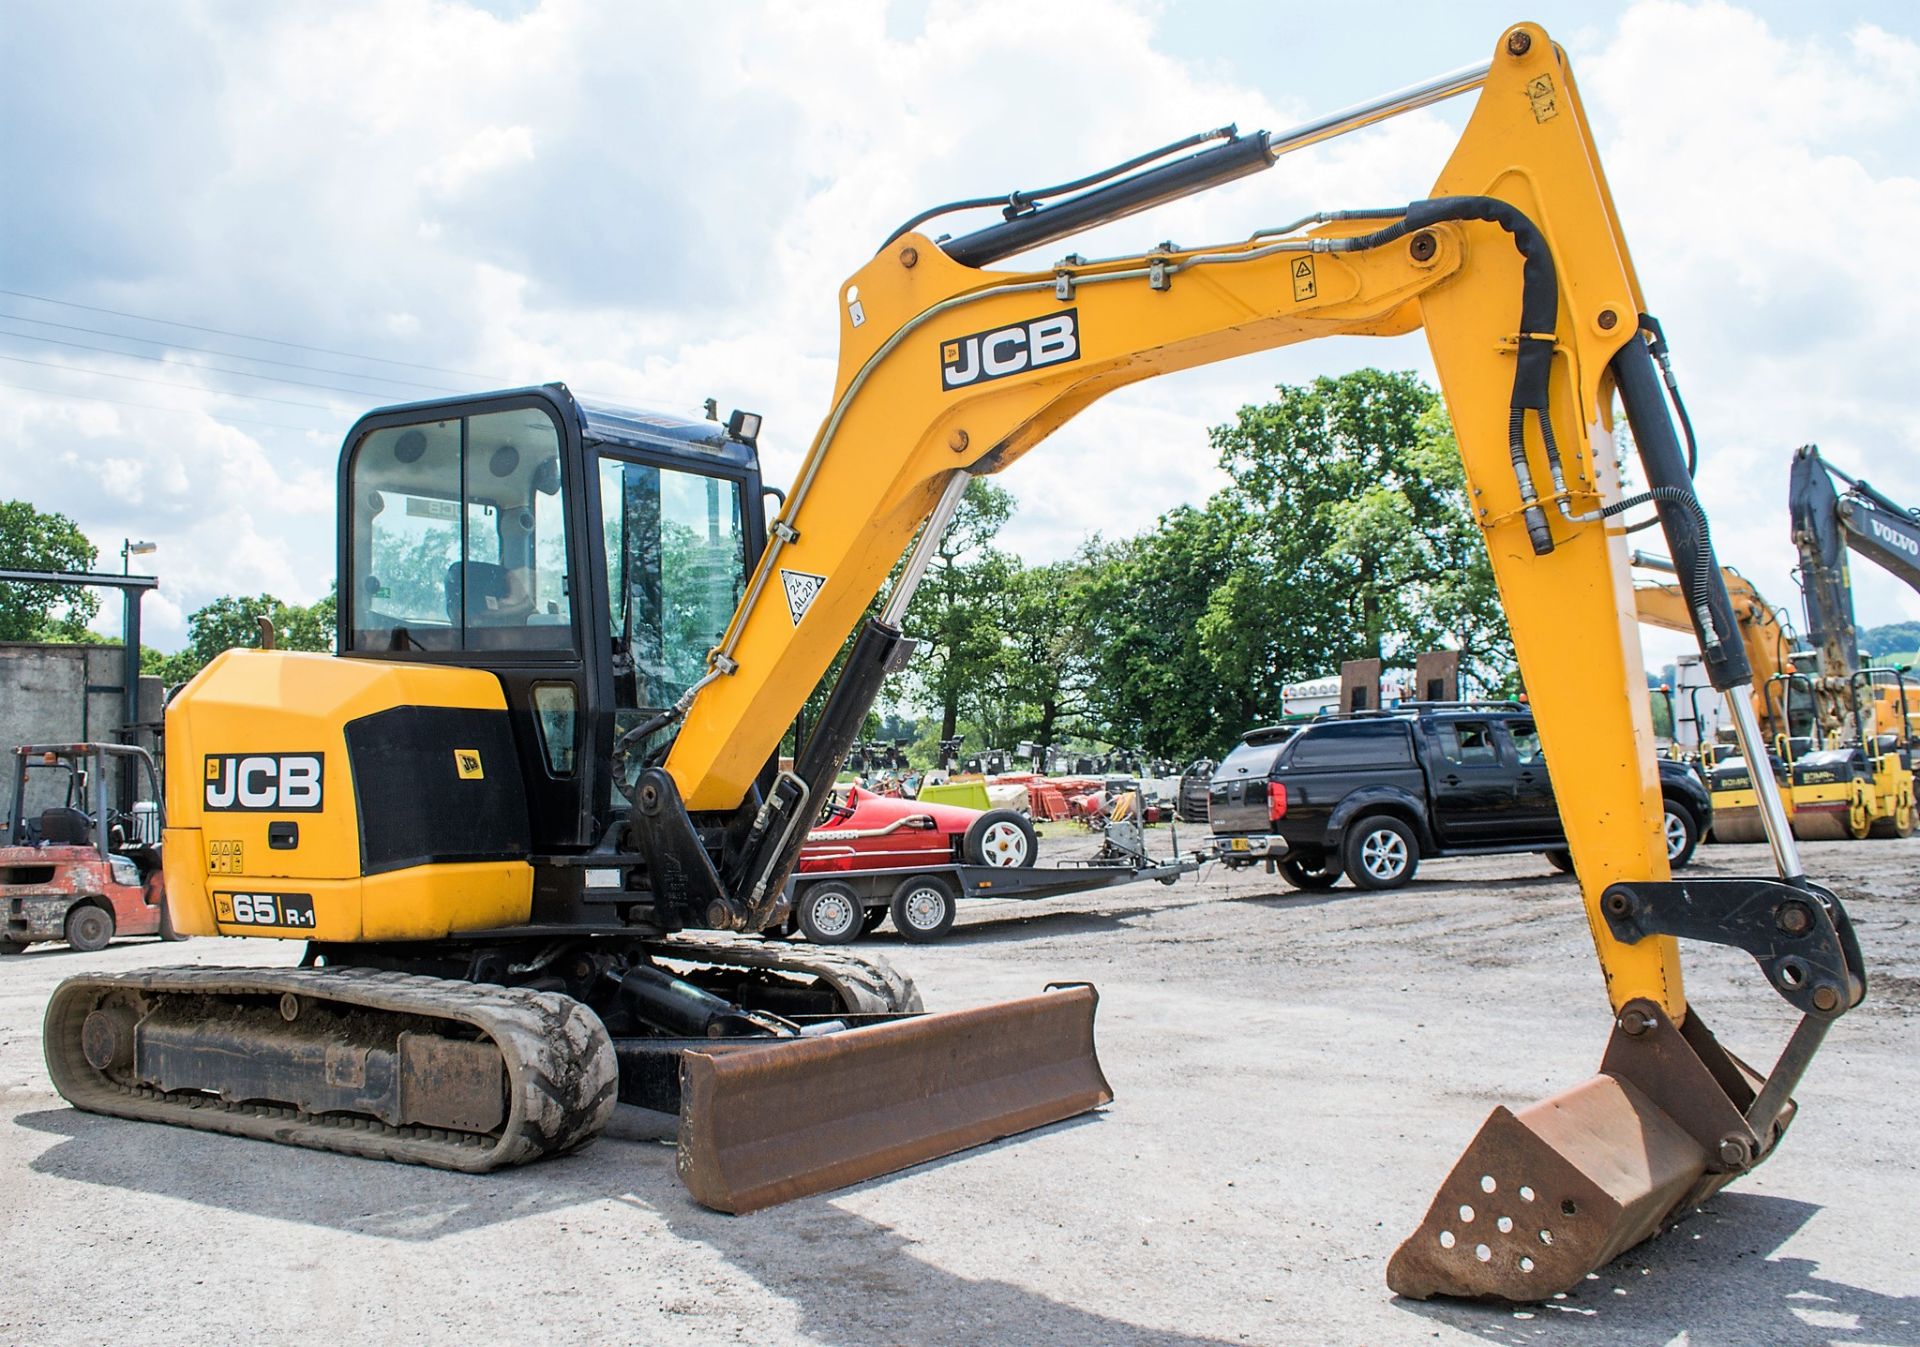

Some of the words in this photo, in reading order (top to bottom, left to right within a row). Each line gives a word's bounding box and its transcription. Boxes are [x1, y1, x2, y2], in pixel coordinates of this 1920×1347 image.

[945, 315, 1077, 386] JCB
[1870, 518, 1919, 556] VOLVO
[789, 578, 802, 595] 24
[205, 757, 321, 808] JCB
[233, 894, 276, 924] 65
[286, 909, 316, 925] R-1
